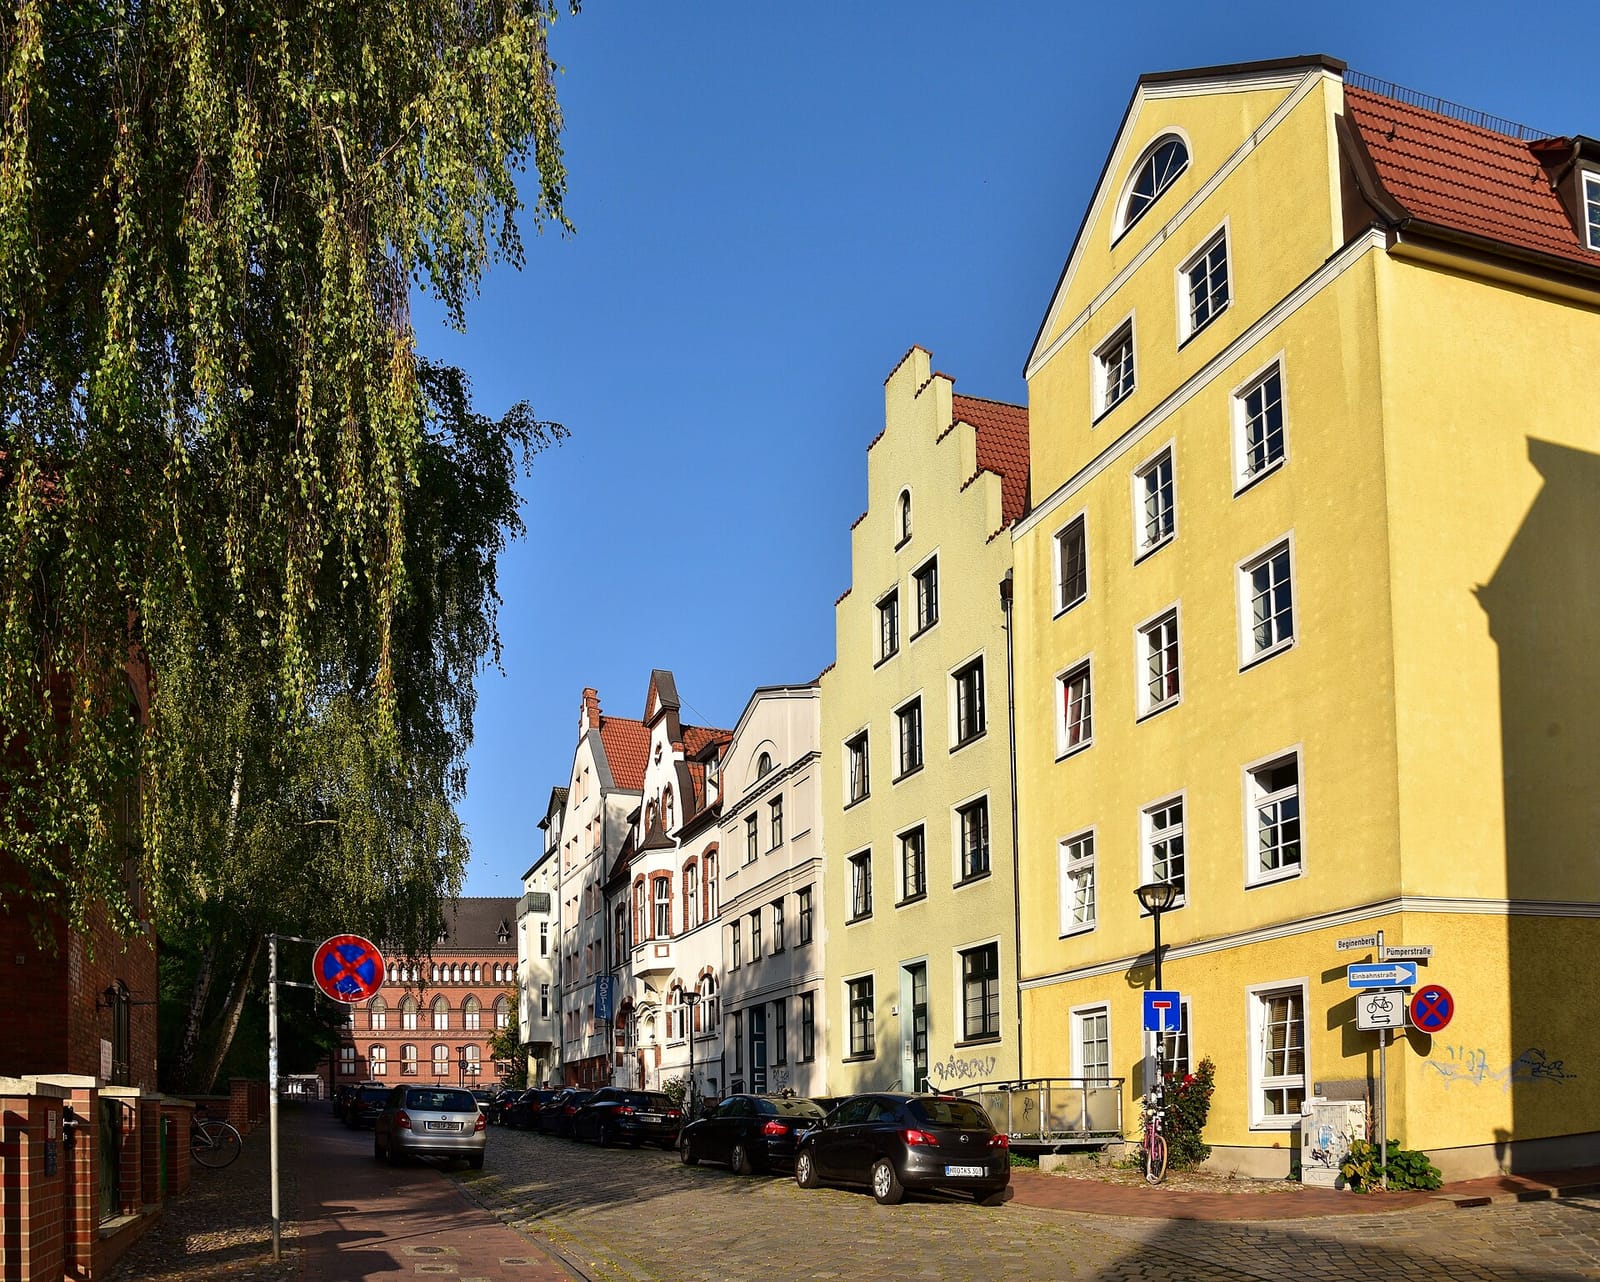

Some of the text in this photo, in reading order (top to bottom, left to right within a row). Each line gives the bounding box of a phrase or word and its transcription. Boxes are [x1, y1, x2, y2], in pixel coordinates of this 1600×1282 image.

[1338, 937, 1375, 949] Beginenberg
[1386, 947, 1431, 957] Pümperstraße
[1351, 972, 1397, 980] Einbahnstraße
